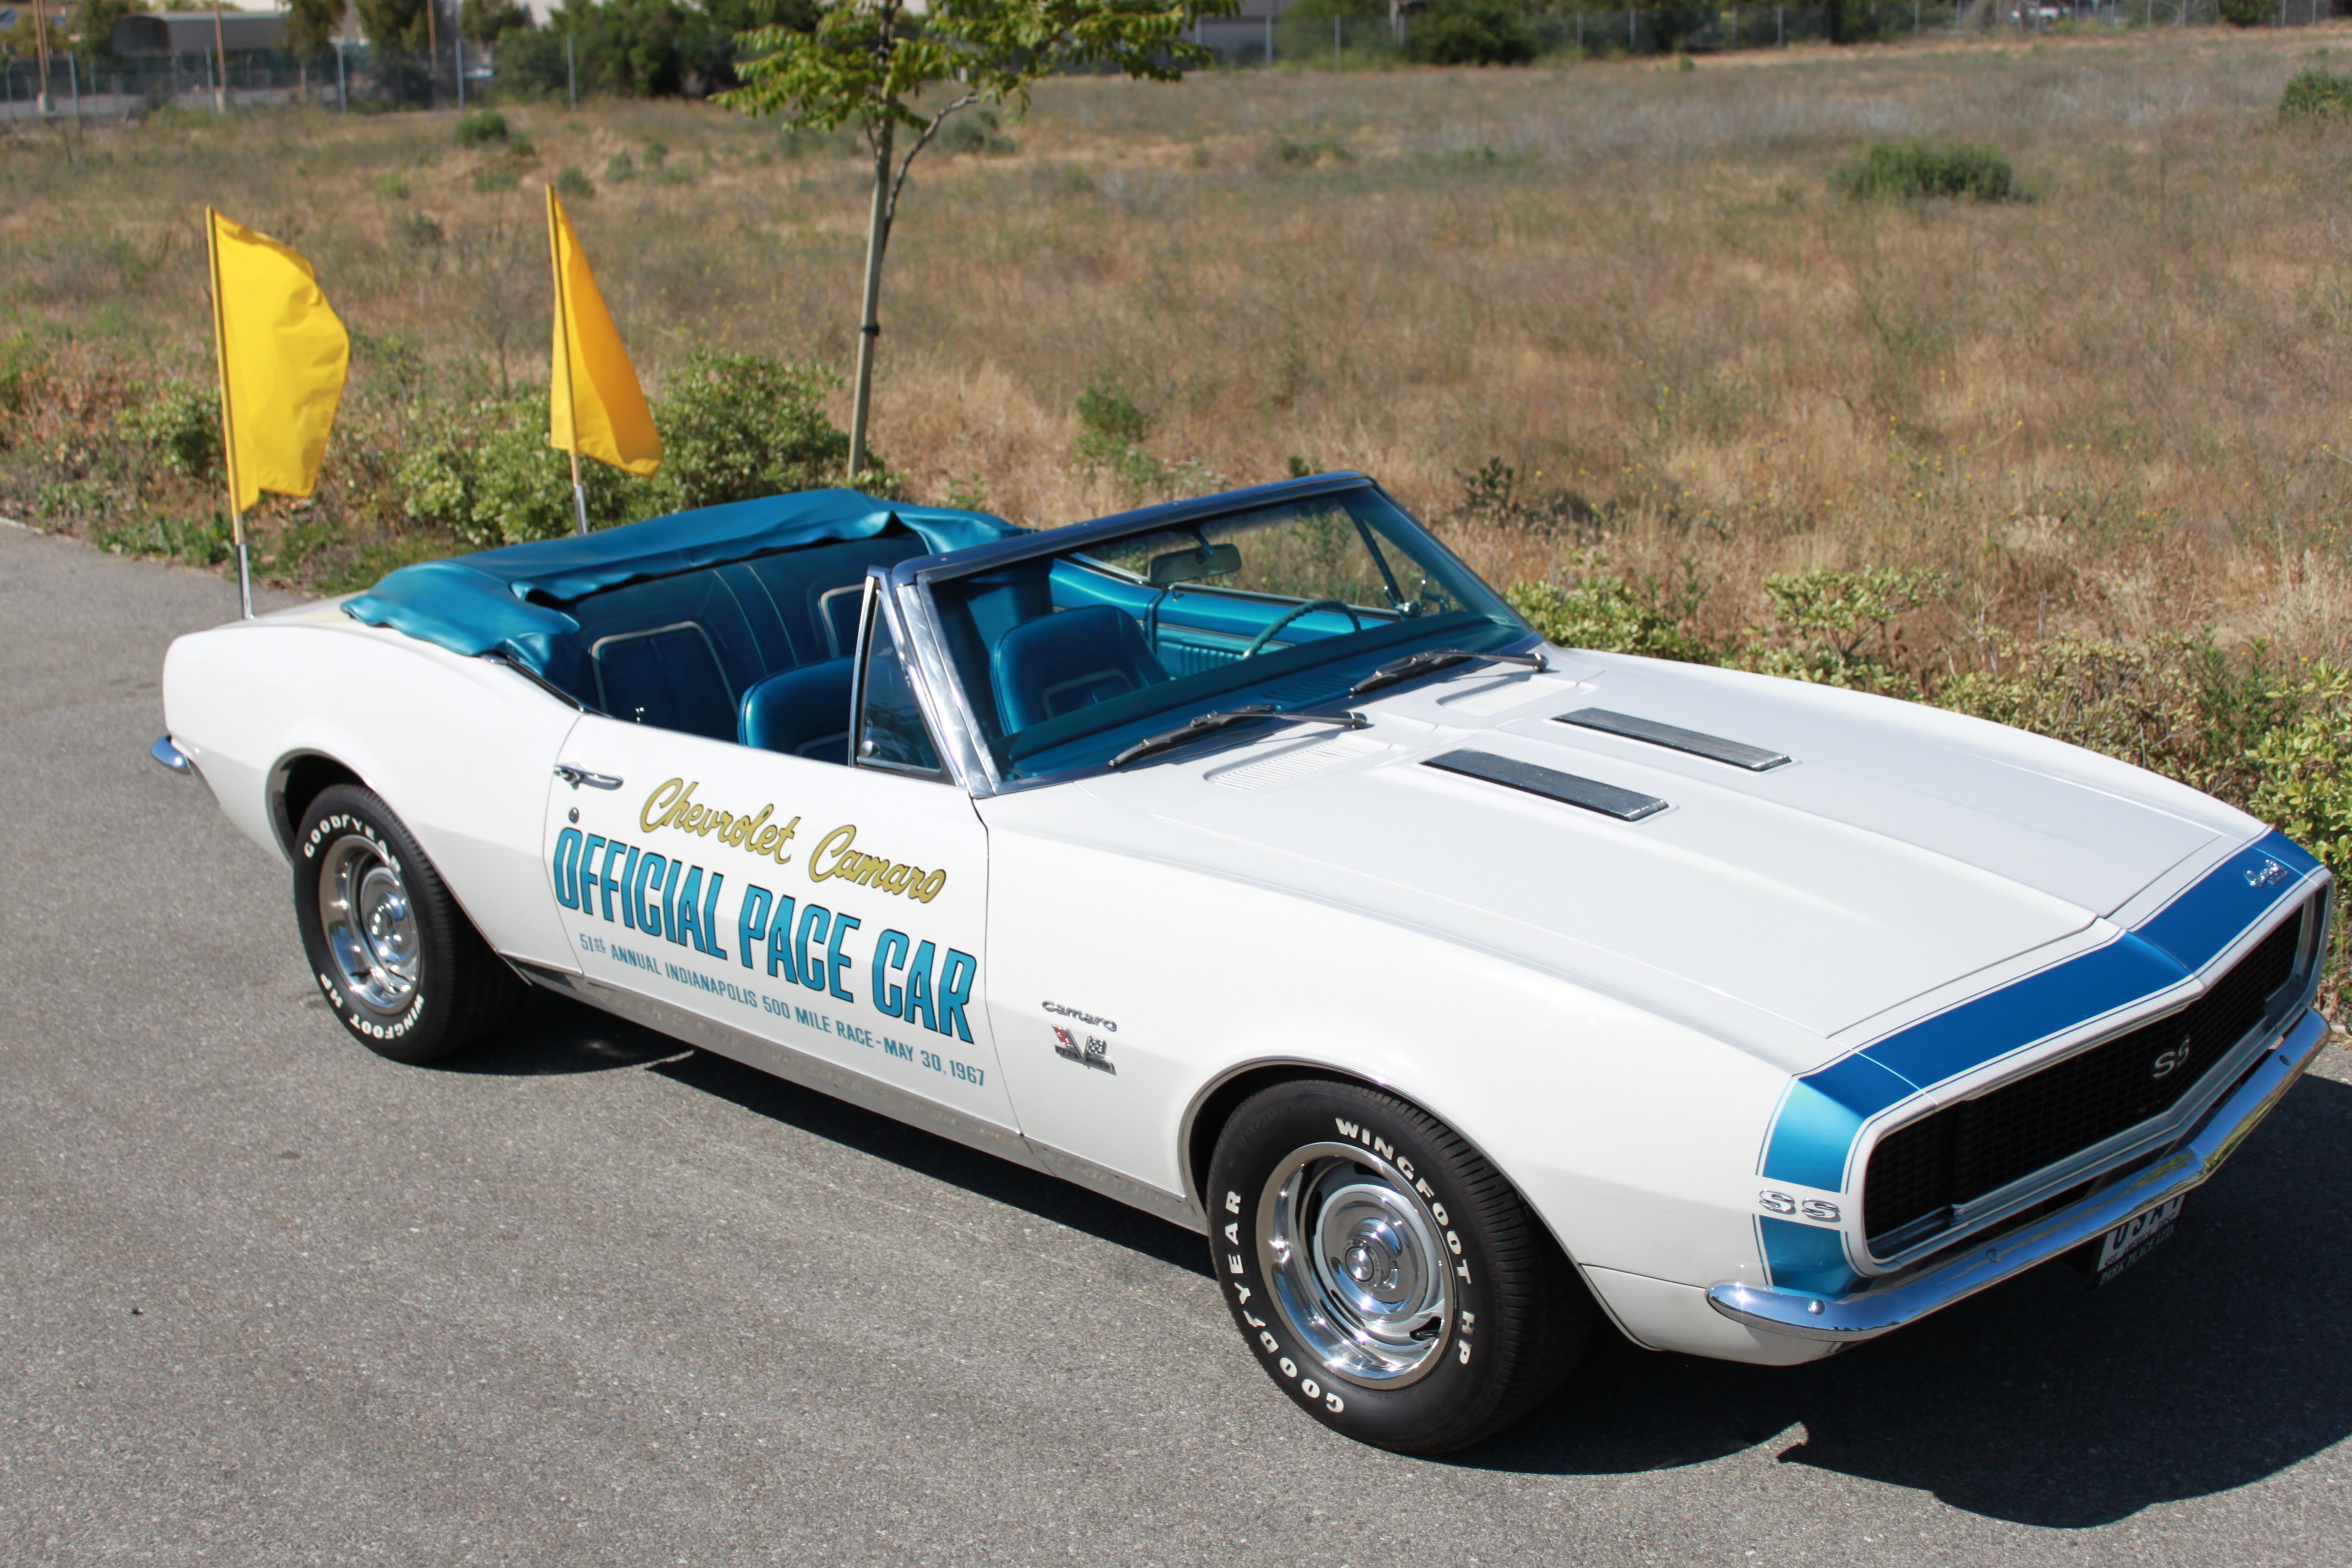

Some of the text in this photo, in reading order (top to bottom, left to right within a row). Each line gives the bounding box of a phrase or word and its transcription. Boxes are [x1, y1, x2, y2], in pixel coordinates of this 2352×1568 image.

[304, 813, 402, 874] GOODYEAR
[640, 777, 947, 903] Chevrolet Camaro
[553, 826, 978, 1045] OFFICIAL PACE CAR
[610, 943, 662, 976] ANNUAL
[664, 961, 758, 1008] INDIANAPOLIS
[762, 996, 791, 1019] 500
[794, 1006, 832, 1034] MILE
[949, 1059, 985, 1087] 1967
[1041, 999, 1118, 1033] Camaro
[2152, 1037, 2190, 1078] SS
[1334, 1117, 1472, 1285] WINGFOOT
[1758, 1188, 1841, 1222] SS
[1224, 1190, 1345, 1414] GOODYEAR
[1458, 1310, 1476, 1366] HP
